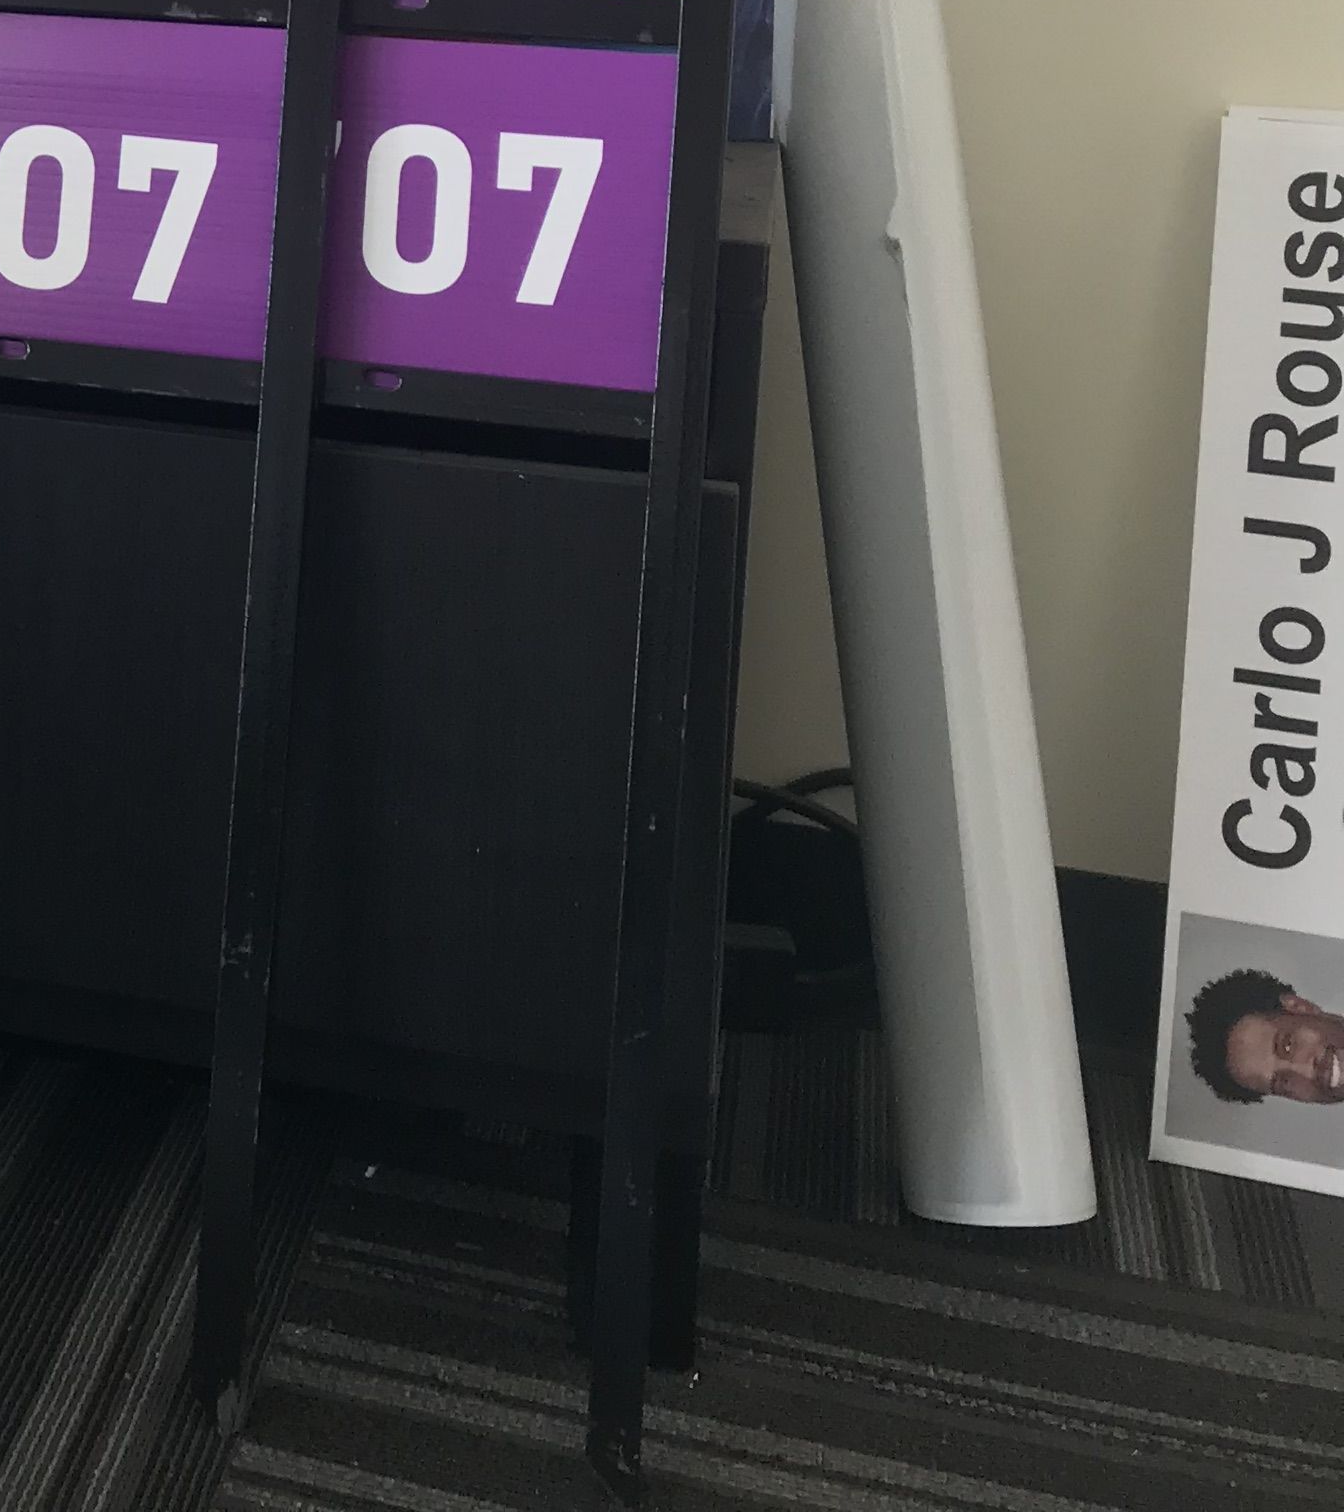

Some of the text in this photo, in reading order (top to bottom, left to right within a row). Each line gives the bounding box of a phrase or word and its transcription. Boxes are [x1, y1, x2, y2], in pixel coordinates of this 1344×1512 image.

[334, 120, 604, 305] 07
[1222, 171, 1344, 869] Carlo J Rouse
